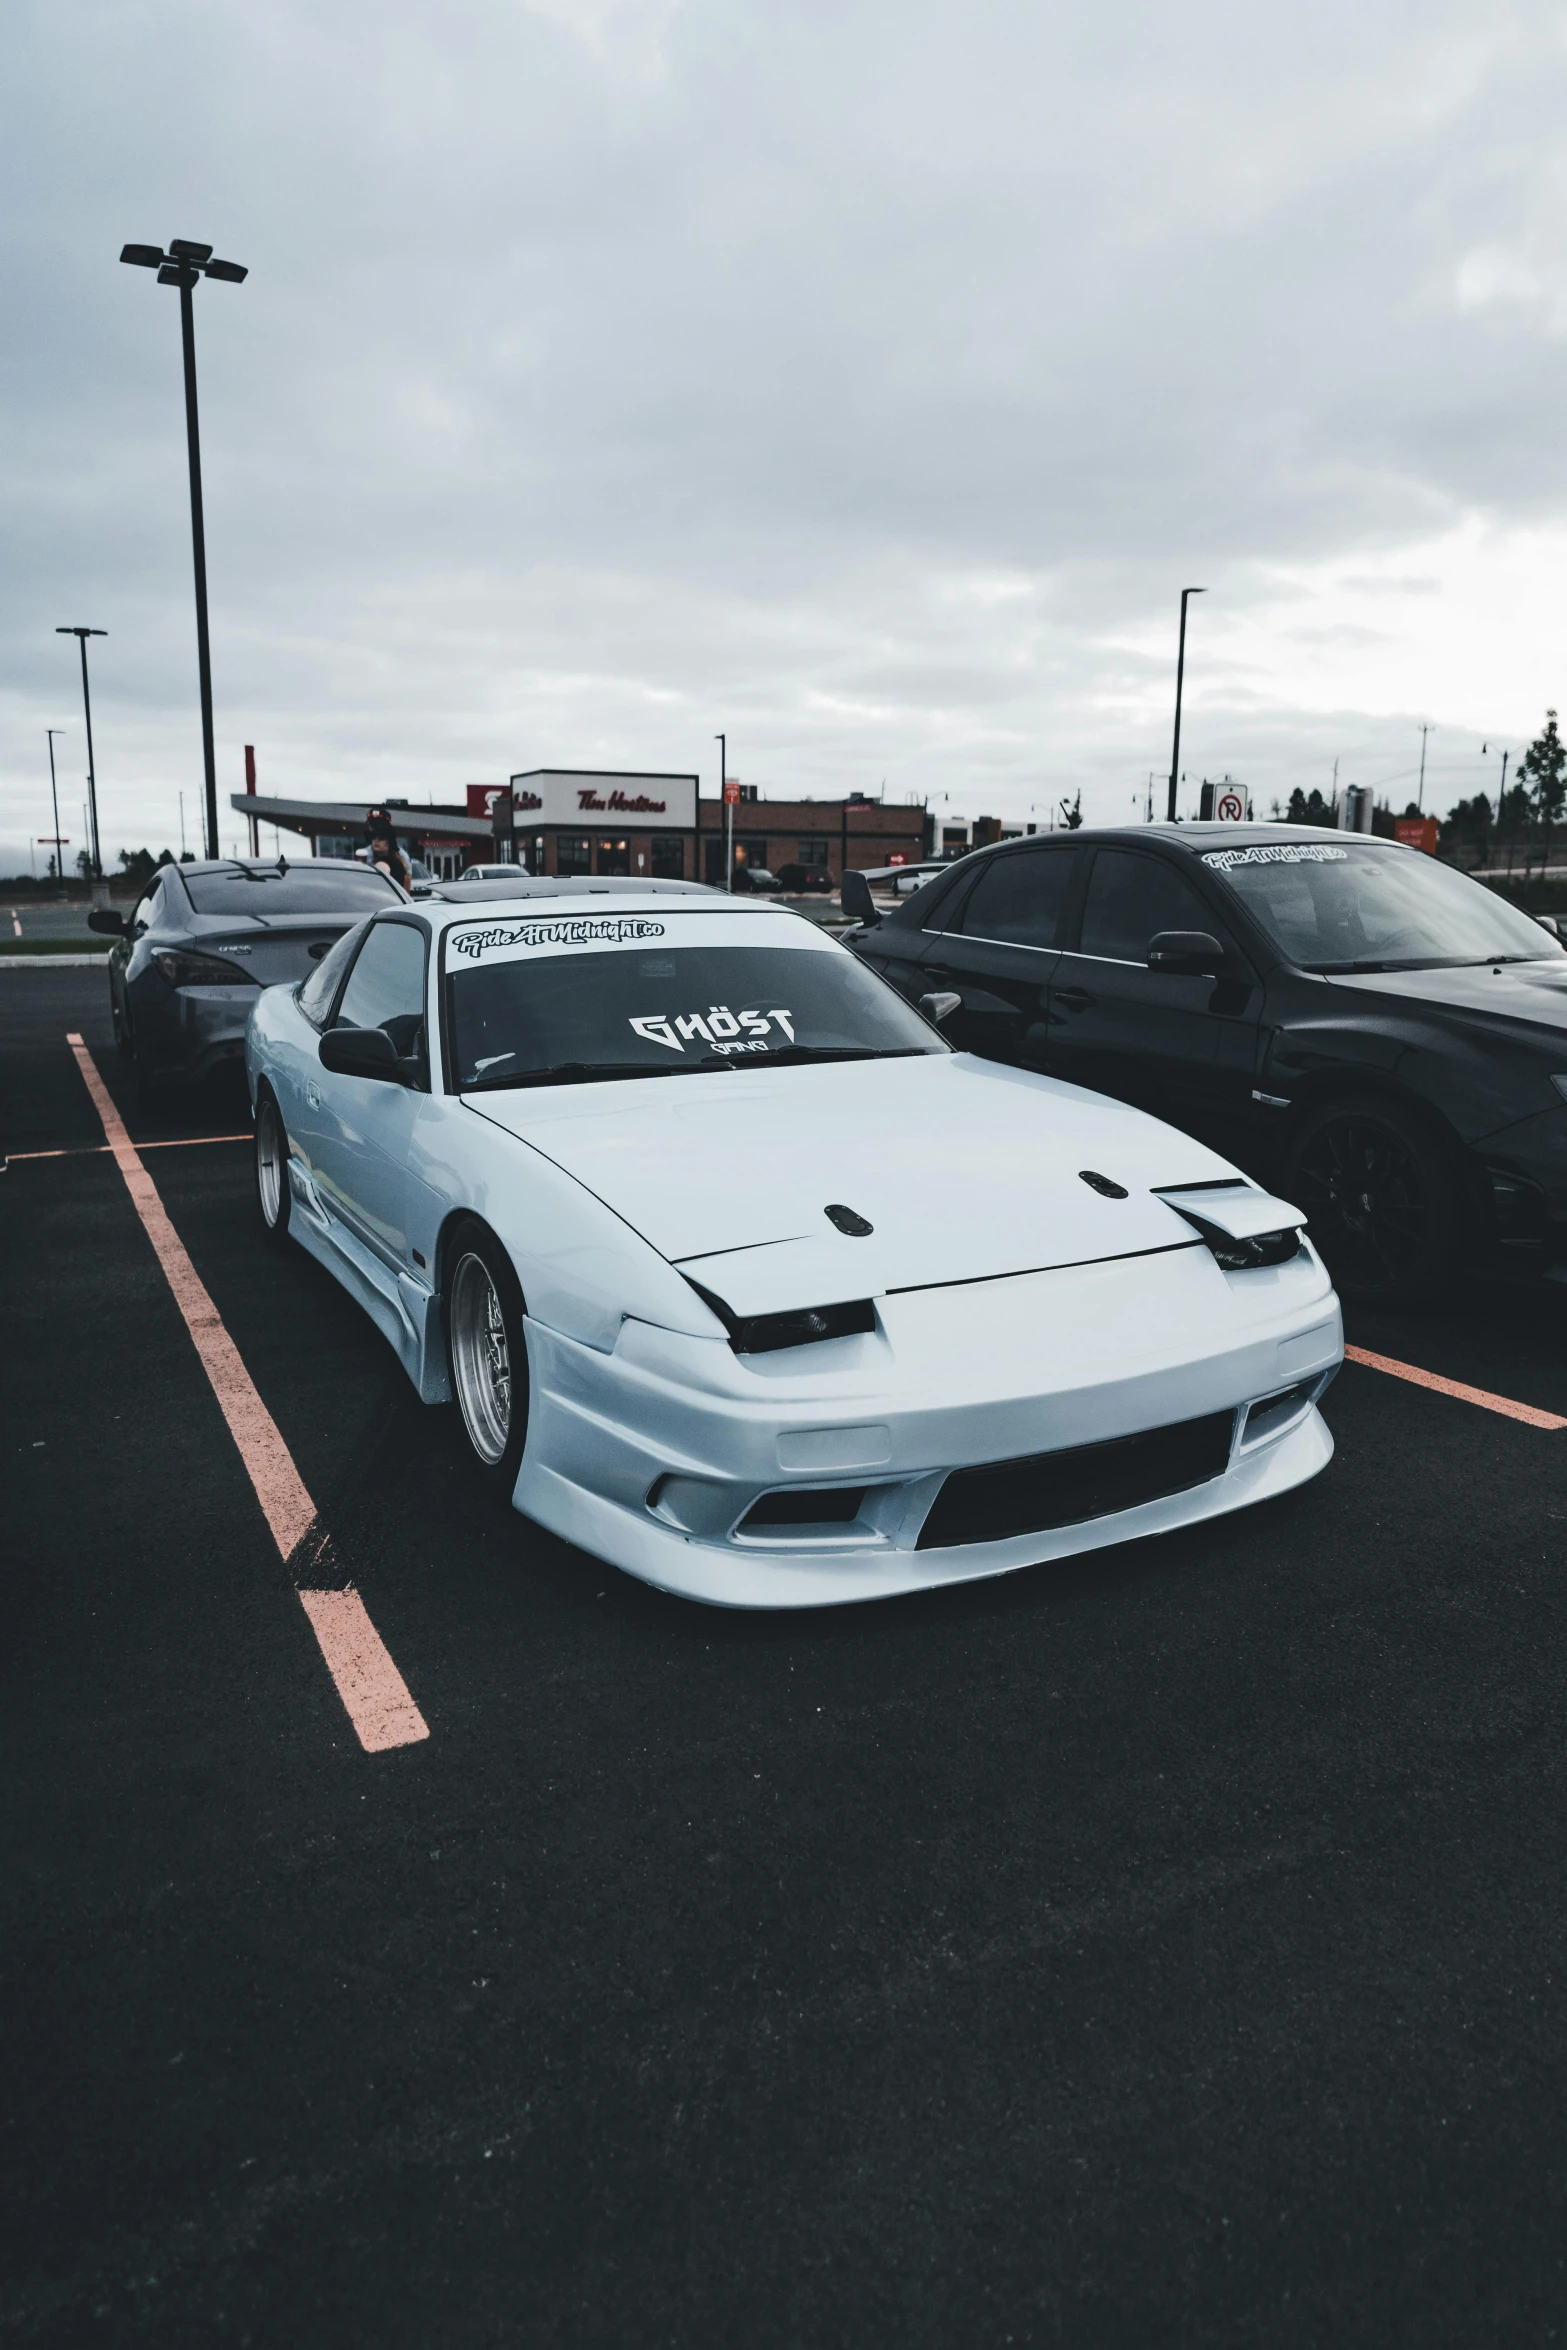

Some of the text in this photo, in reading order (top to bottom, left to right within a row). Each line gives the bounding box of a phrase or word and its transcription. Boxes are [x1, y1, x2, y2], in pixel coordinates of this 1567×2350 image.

[577, 790, 666, 813] Tim Hortons
[628, 1006, 795, 1053] GHÖST
[709, 1040, 769, 1056] GANG
